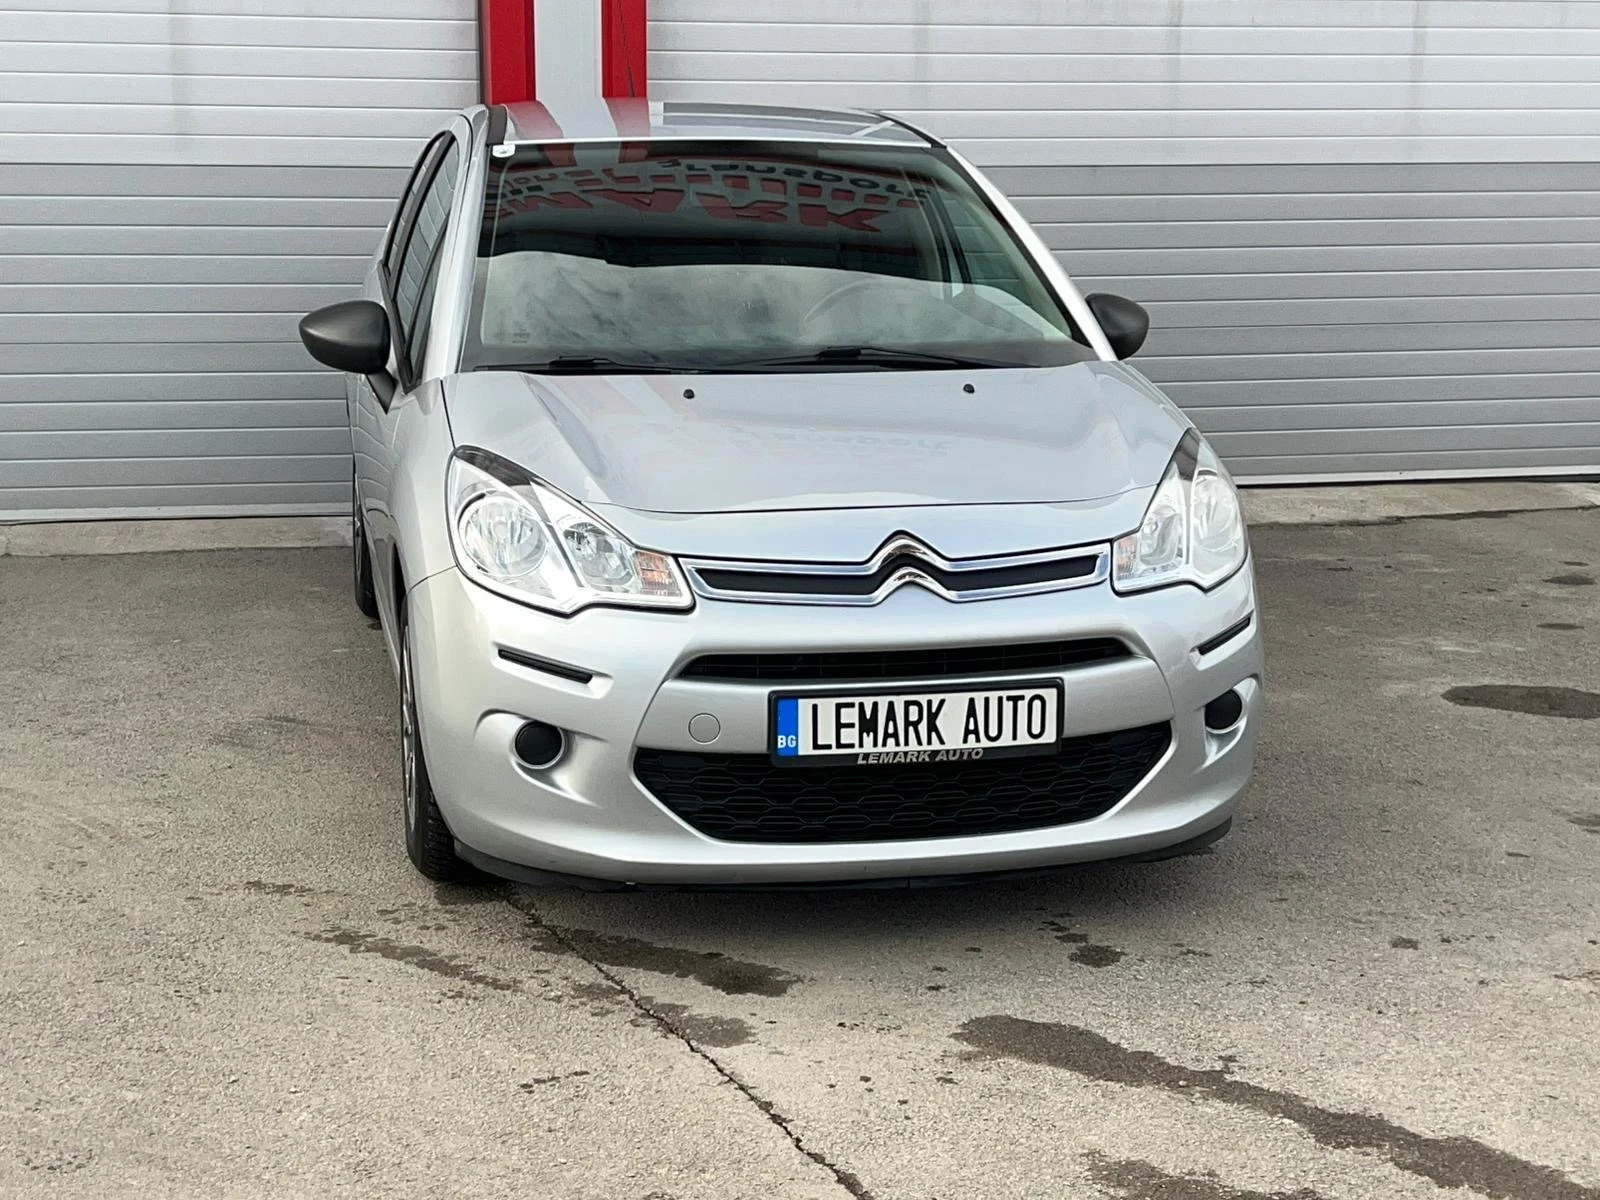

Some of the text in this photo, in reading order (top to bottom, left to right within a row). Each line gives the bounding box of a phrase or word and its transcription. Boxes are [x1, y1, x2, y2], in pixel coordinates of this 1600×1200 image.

[811, 694, 1047, 750] LEMARK AUTO
[777, 735, 797, 749] BG
[857, 748, 983, 765] LEMARK AUTO
